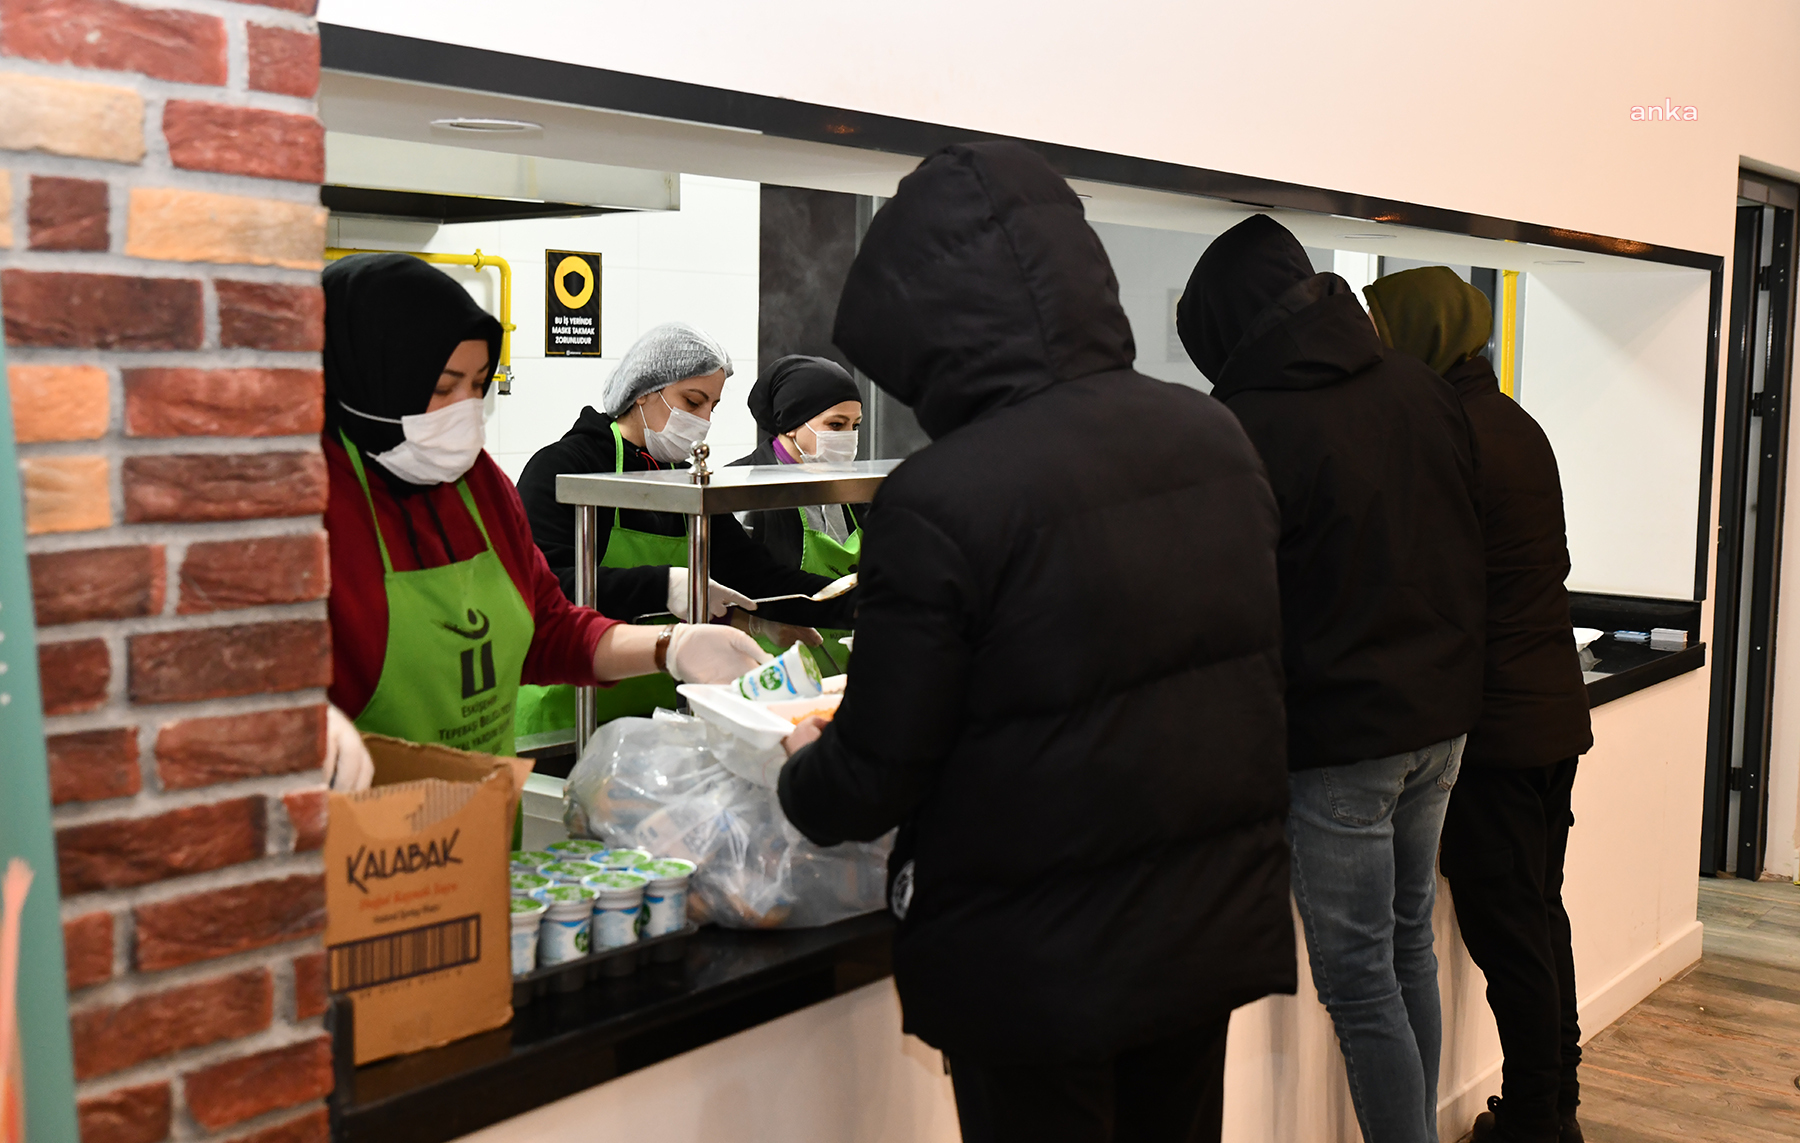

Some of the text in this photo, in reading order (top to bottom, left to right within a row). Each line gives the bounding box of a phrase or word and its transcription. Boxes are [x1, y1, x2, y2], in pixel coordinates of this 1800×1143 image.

[555, 316, 563, 325] BU
[570, 316, 593, 326] YERİNDE
[552, 326, 595, 335] MASKE TAKMAK
[555, 336, 592, 345] ZORUNLUDUR
[346, 828, 463, 894] KALABAK
